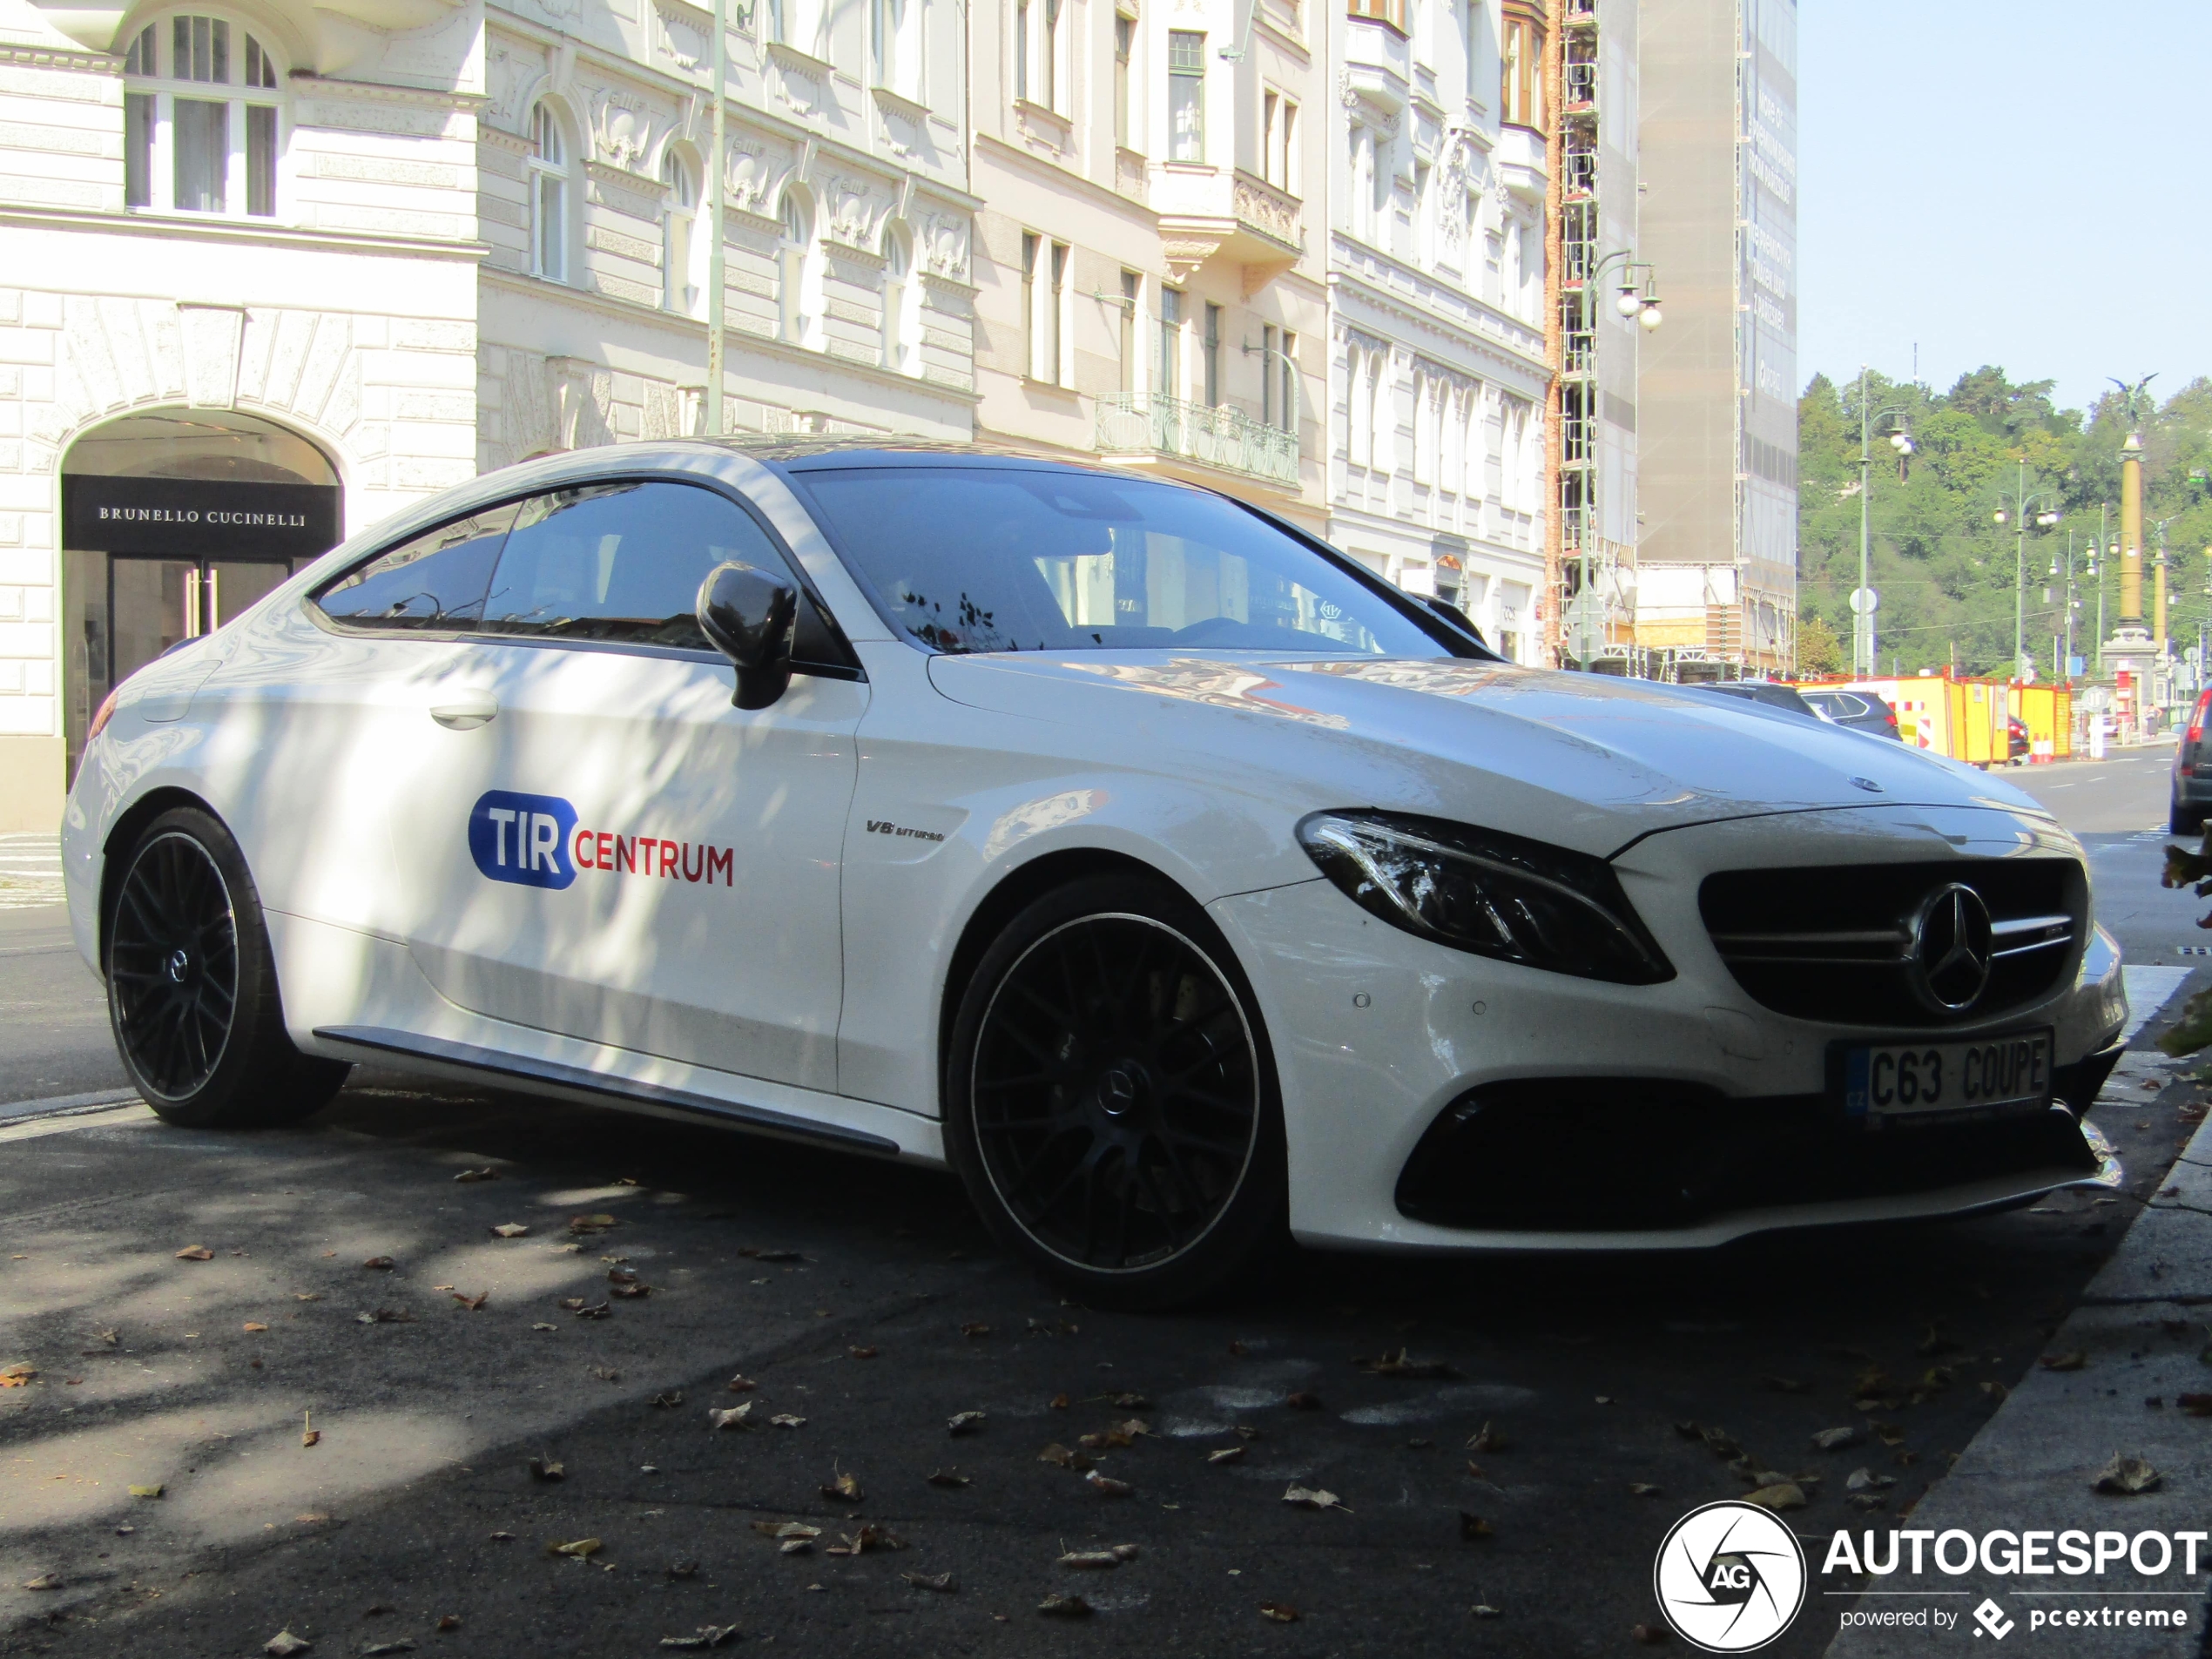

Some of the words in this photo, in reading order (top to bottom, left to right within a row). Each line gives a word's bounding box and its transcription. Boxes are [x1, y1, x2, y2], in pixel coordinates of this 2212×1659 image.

[99, 507, 199, 523] BRUNELLO
[207, 512, 306, 527] CUCINELLI
[489, 807, 561, 873] TIR
[575, 830, 734, 887] CENTRUM
[867, 820, 895, 834] V8
[896, 827, 945, 842] BITURBO
[1872, 1050, 1942, 1106] C63
[1964, 1038, 2046, 1099] COUPE
